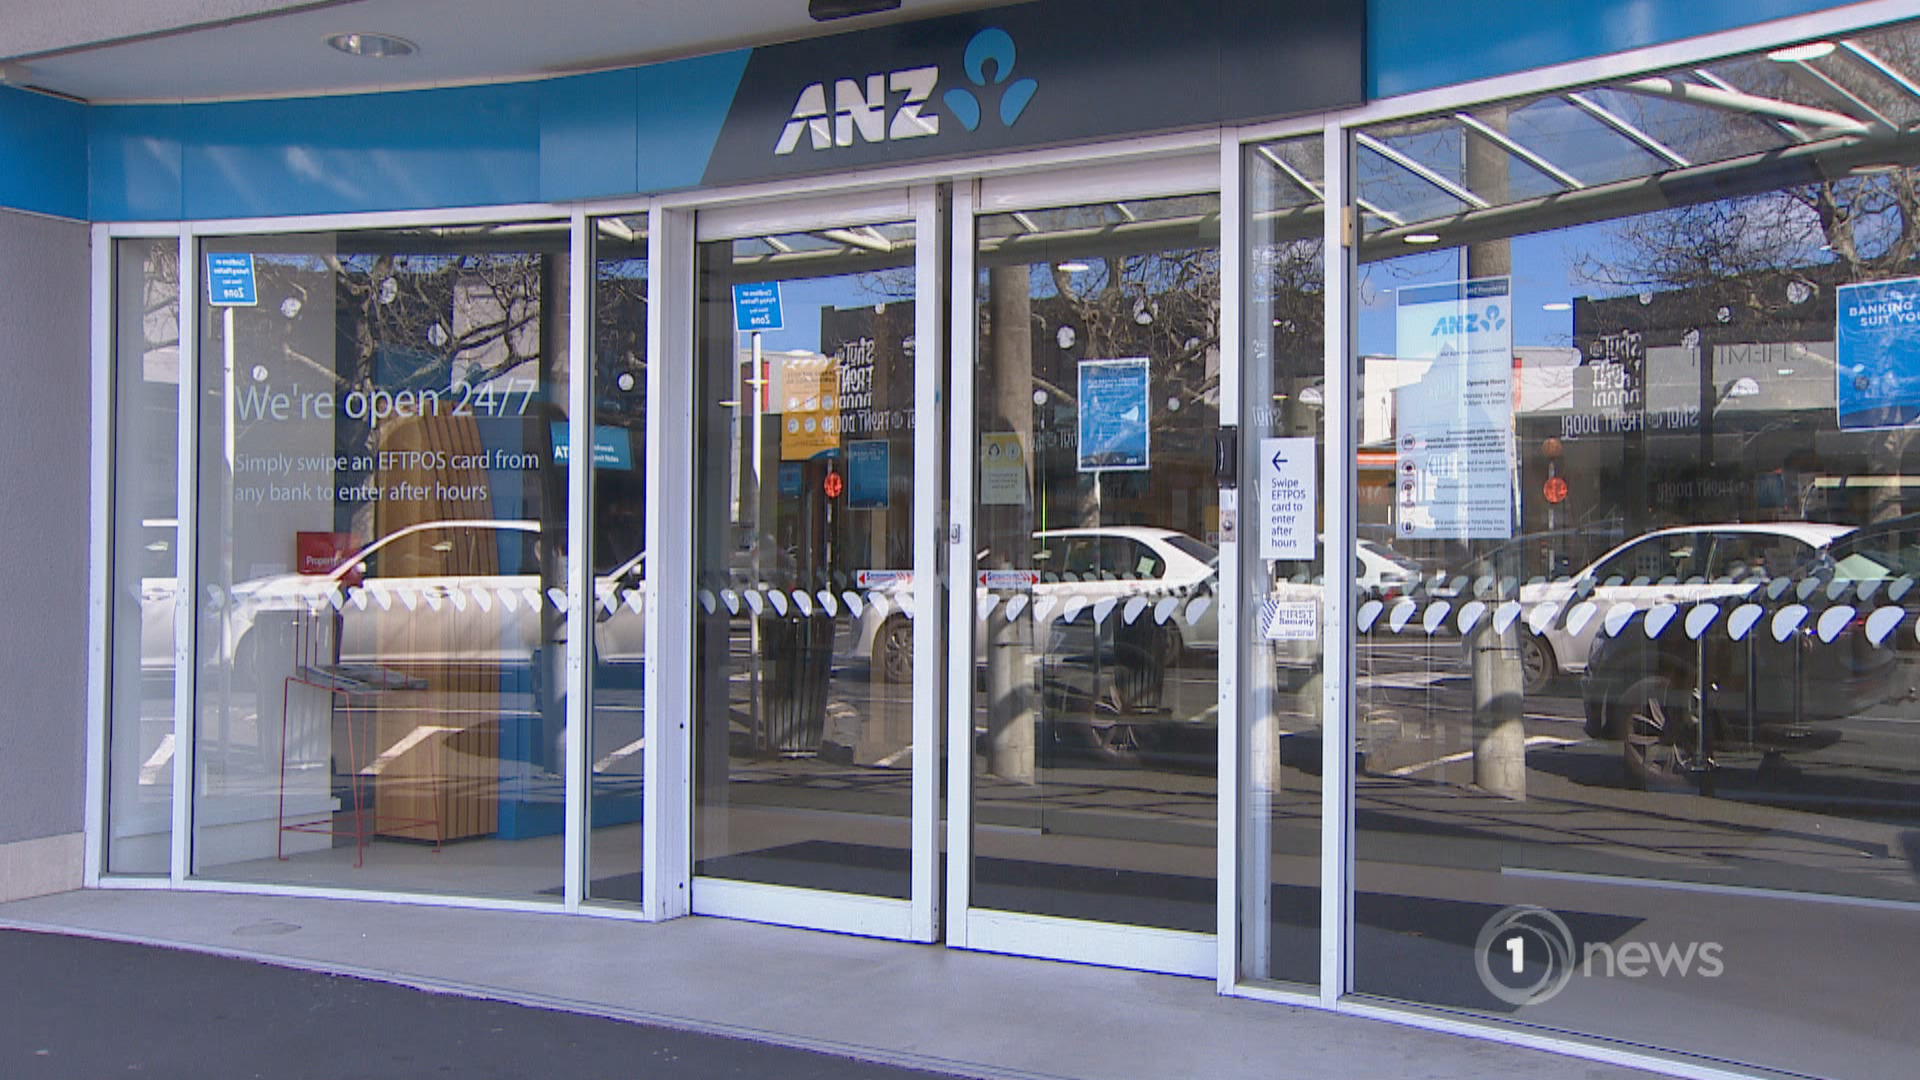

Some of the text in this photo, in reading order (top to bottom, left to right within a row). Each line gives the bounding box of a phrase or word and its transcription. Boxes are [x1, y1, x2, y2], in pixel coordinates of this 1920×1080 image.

[775, 64, 940, 155] ANZ
[1849, 301, 1913, 317] BANKING
[1431, 313, 1479, 336] ANZ
[1860, 315, 1890, 327] SUIT
[1466, 378, 1506, 389] Opening Hours
[235, 378, 537, 428] We're open 24/7
[554, 445, 569, 459] AT
[235, 449, 540, 476] Simply swipe an EFTPOS card from
[1271, 478, 1299, 490] Swipe
[235, 481, 488, 506] any bank to enter after hours
[1271, 490, 1307, 500] EFTPOS
[1271, 502, 1304, 513] card to
[1271, 515, 1296, 525] enter
[1271, 527, 1293, 537] after
[1271, 538, 1298, 548] hours
[1280, 609, 1315, 619] FIRST
[1279, 618, 1314, 627] Security
